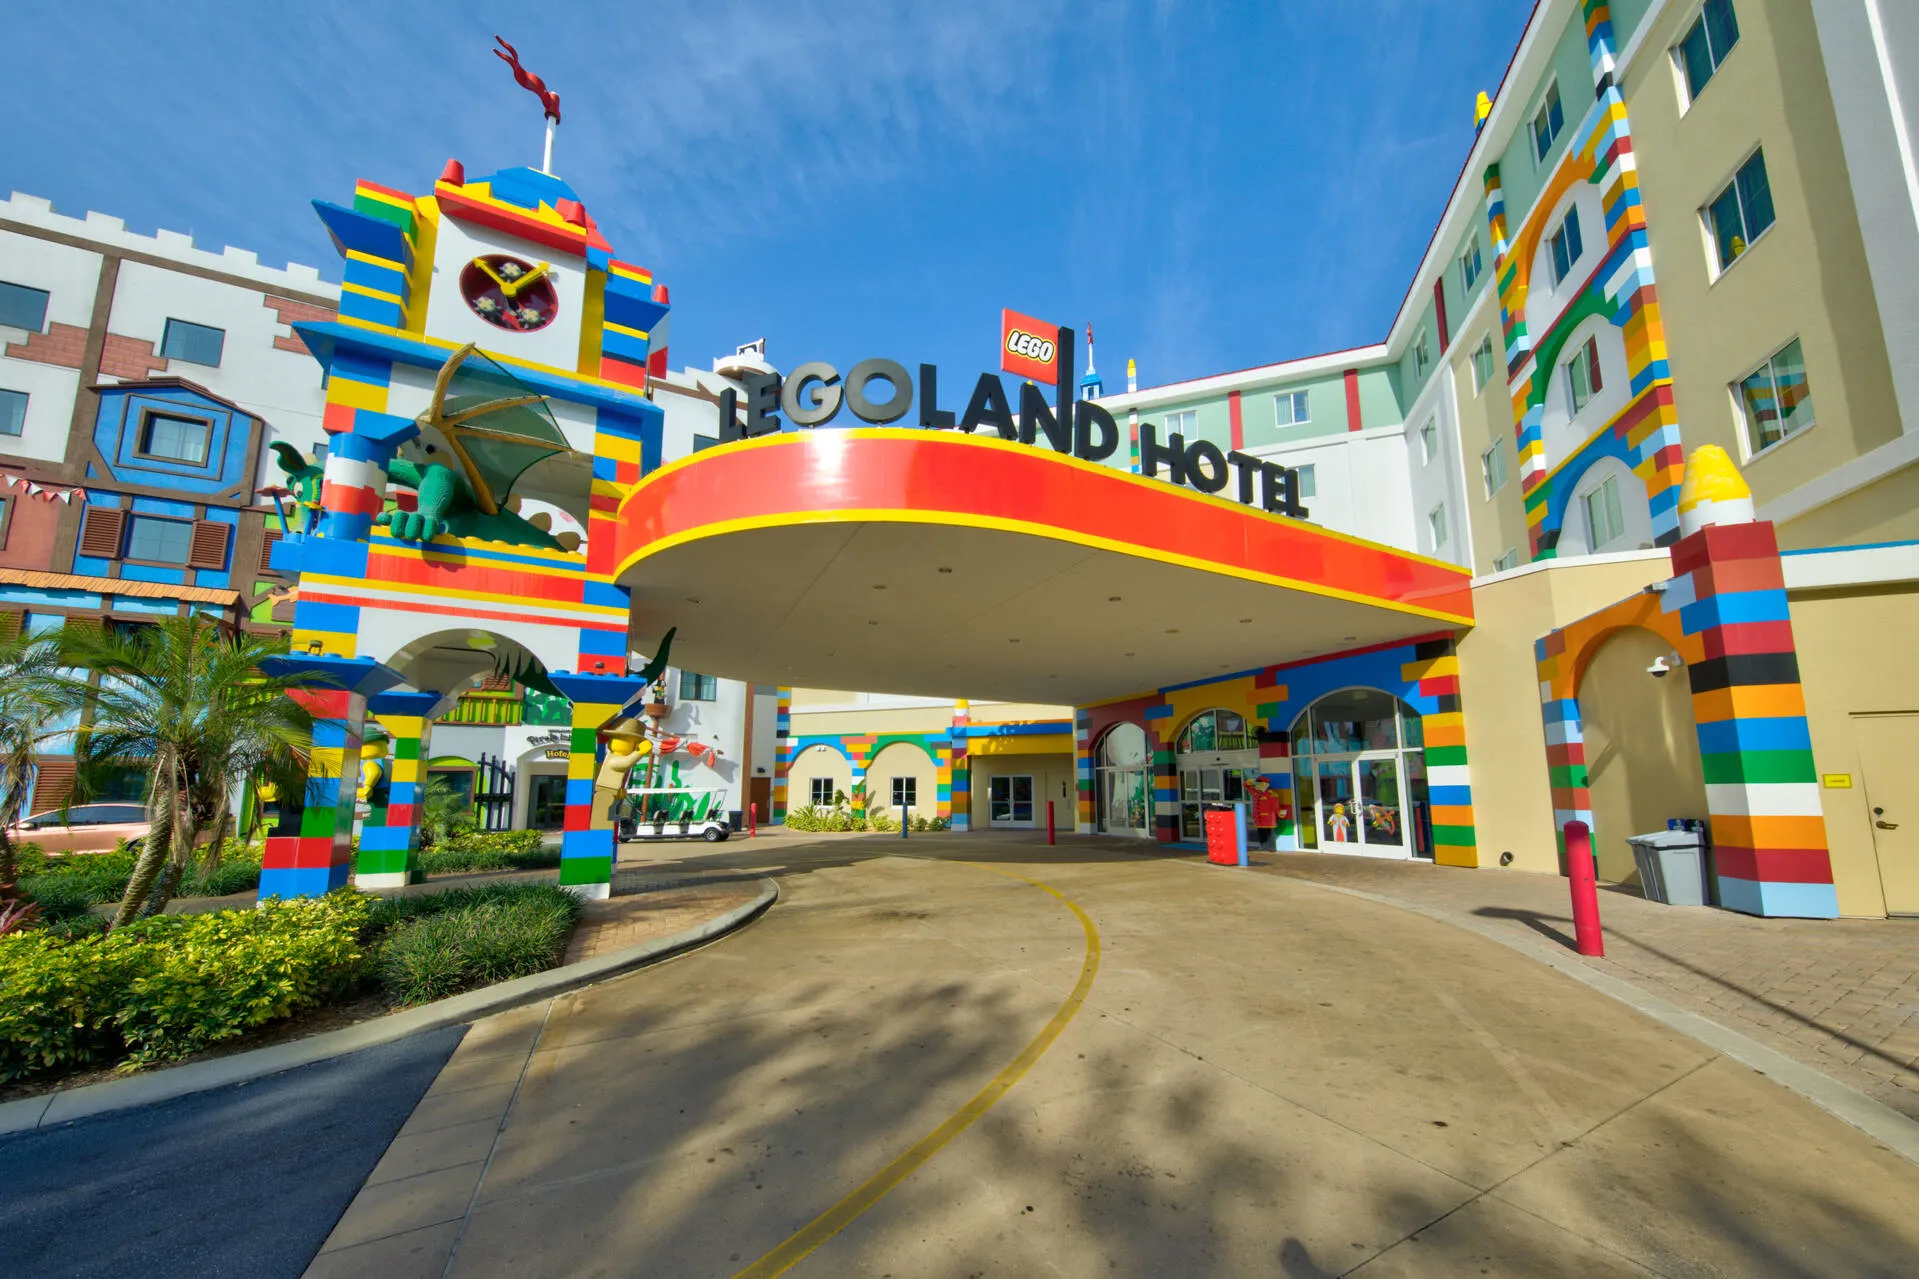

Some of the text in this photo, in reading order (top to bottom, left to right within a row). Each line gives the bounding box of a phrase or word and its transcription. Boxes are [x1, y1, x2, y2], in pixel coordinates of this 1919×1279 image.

[1006, 329, 1055, 364] LEGO
[720, 326, 1308, 518] LEGOLAND HOTEL
